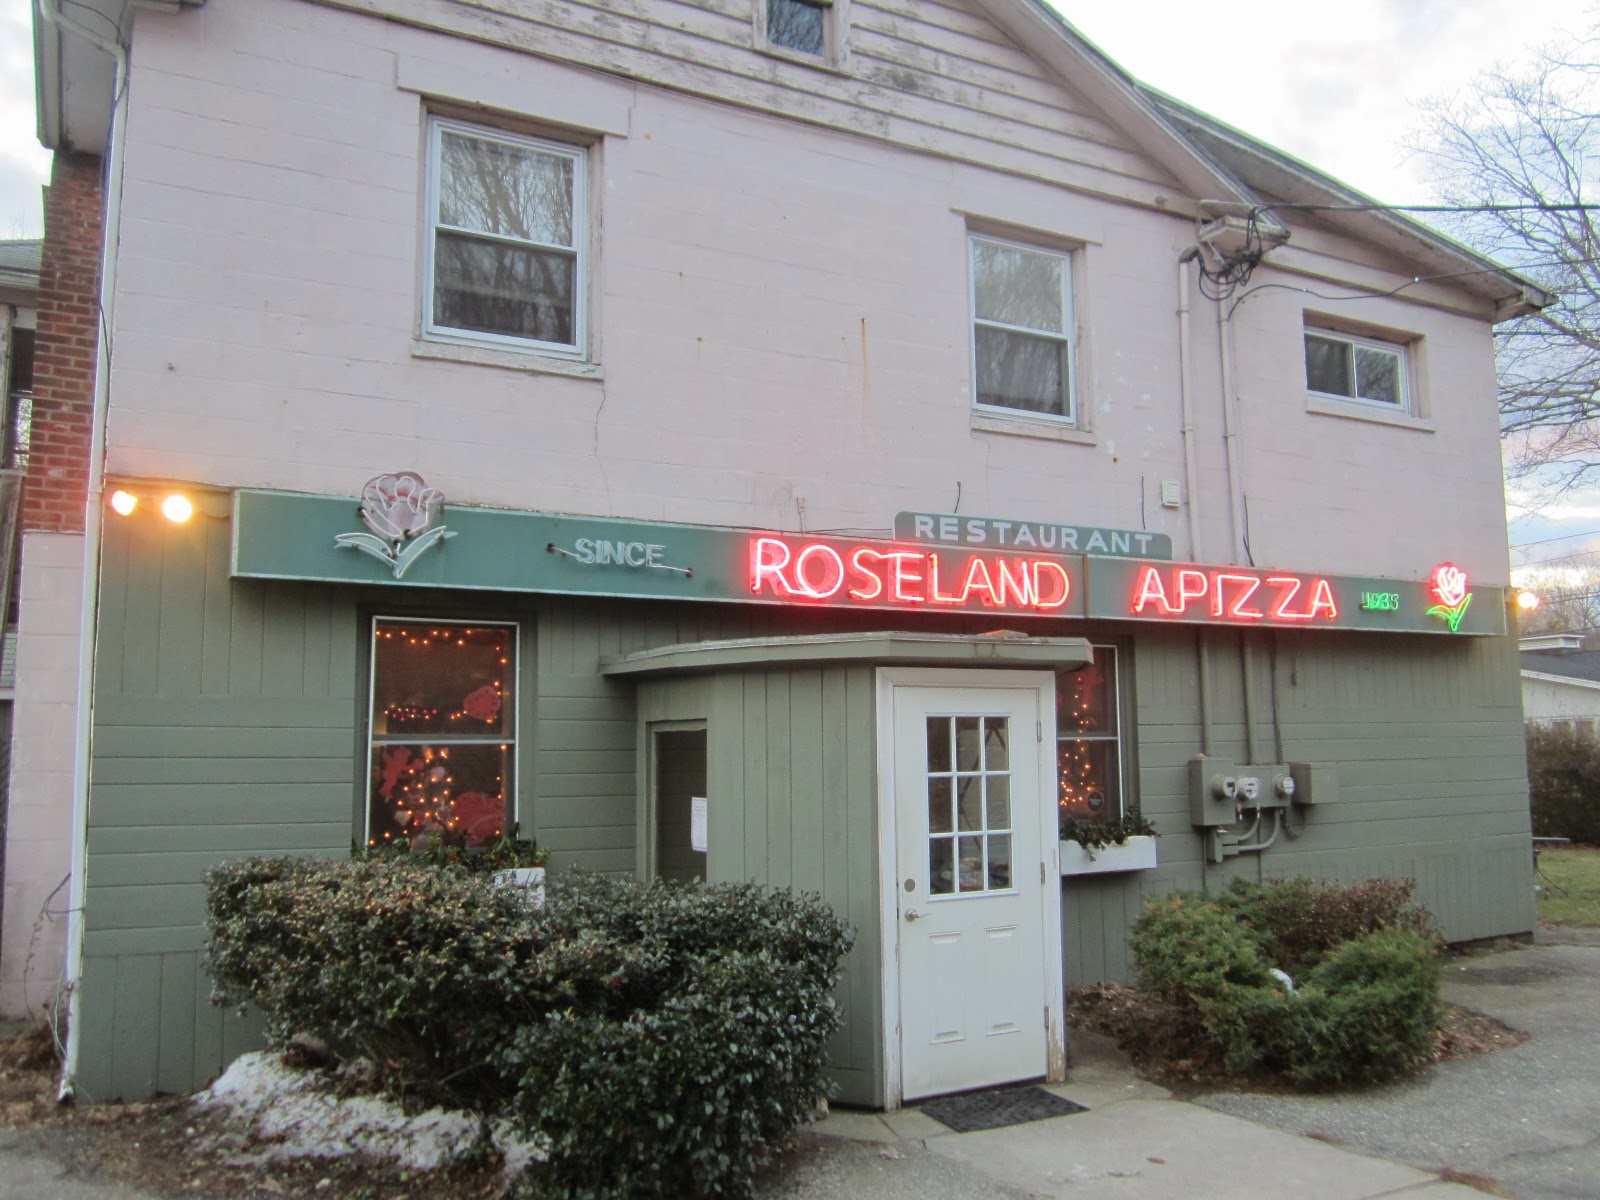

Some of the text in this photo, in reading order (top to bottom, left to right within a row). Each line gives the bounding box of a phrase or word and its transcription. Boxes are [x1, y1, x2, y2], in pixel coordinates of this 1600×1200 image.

[914, 514, 1153, 555] RESTAURANT
[575, 538, 666, 567] SINCE
[749, 538, 1070, 609] ROSELAND
[1133, 566, 1338, 621] APIZZA
